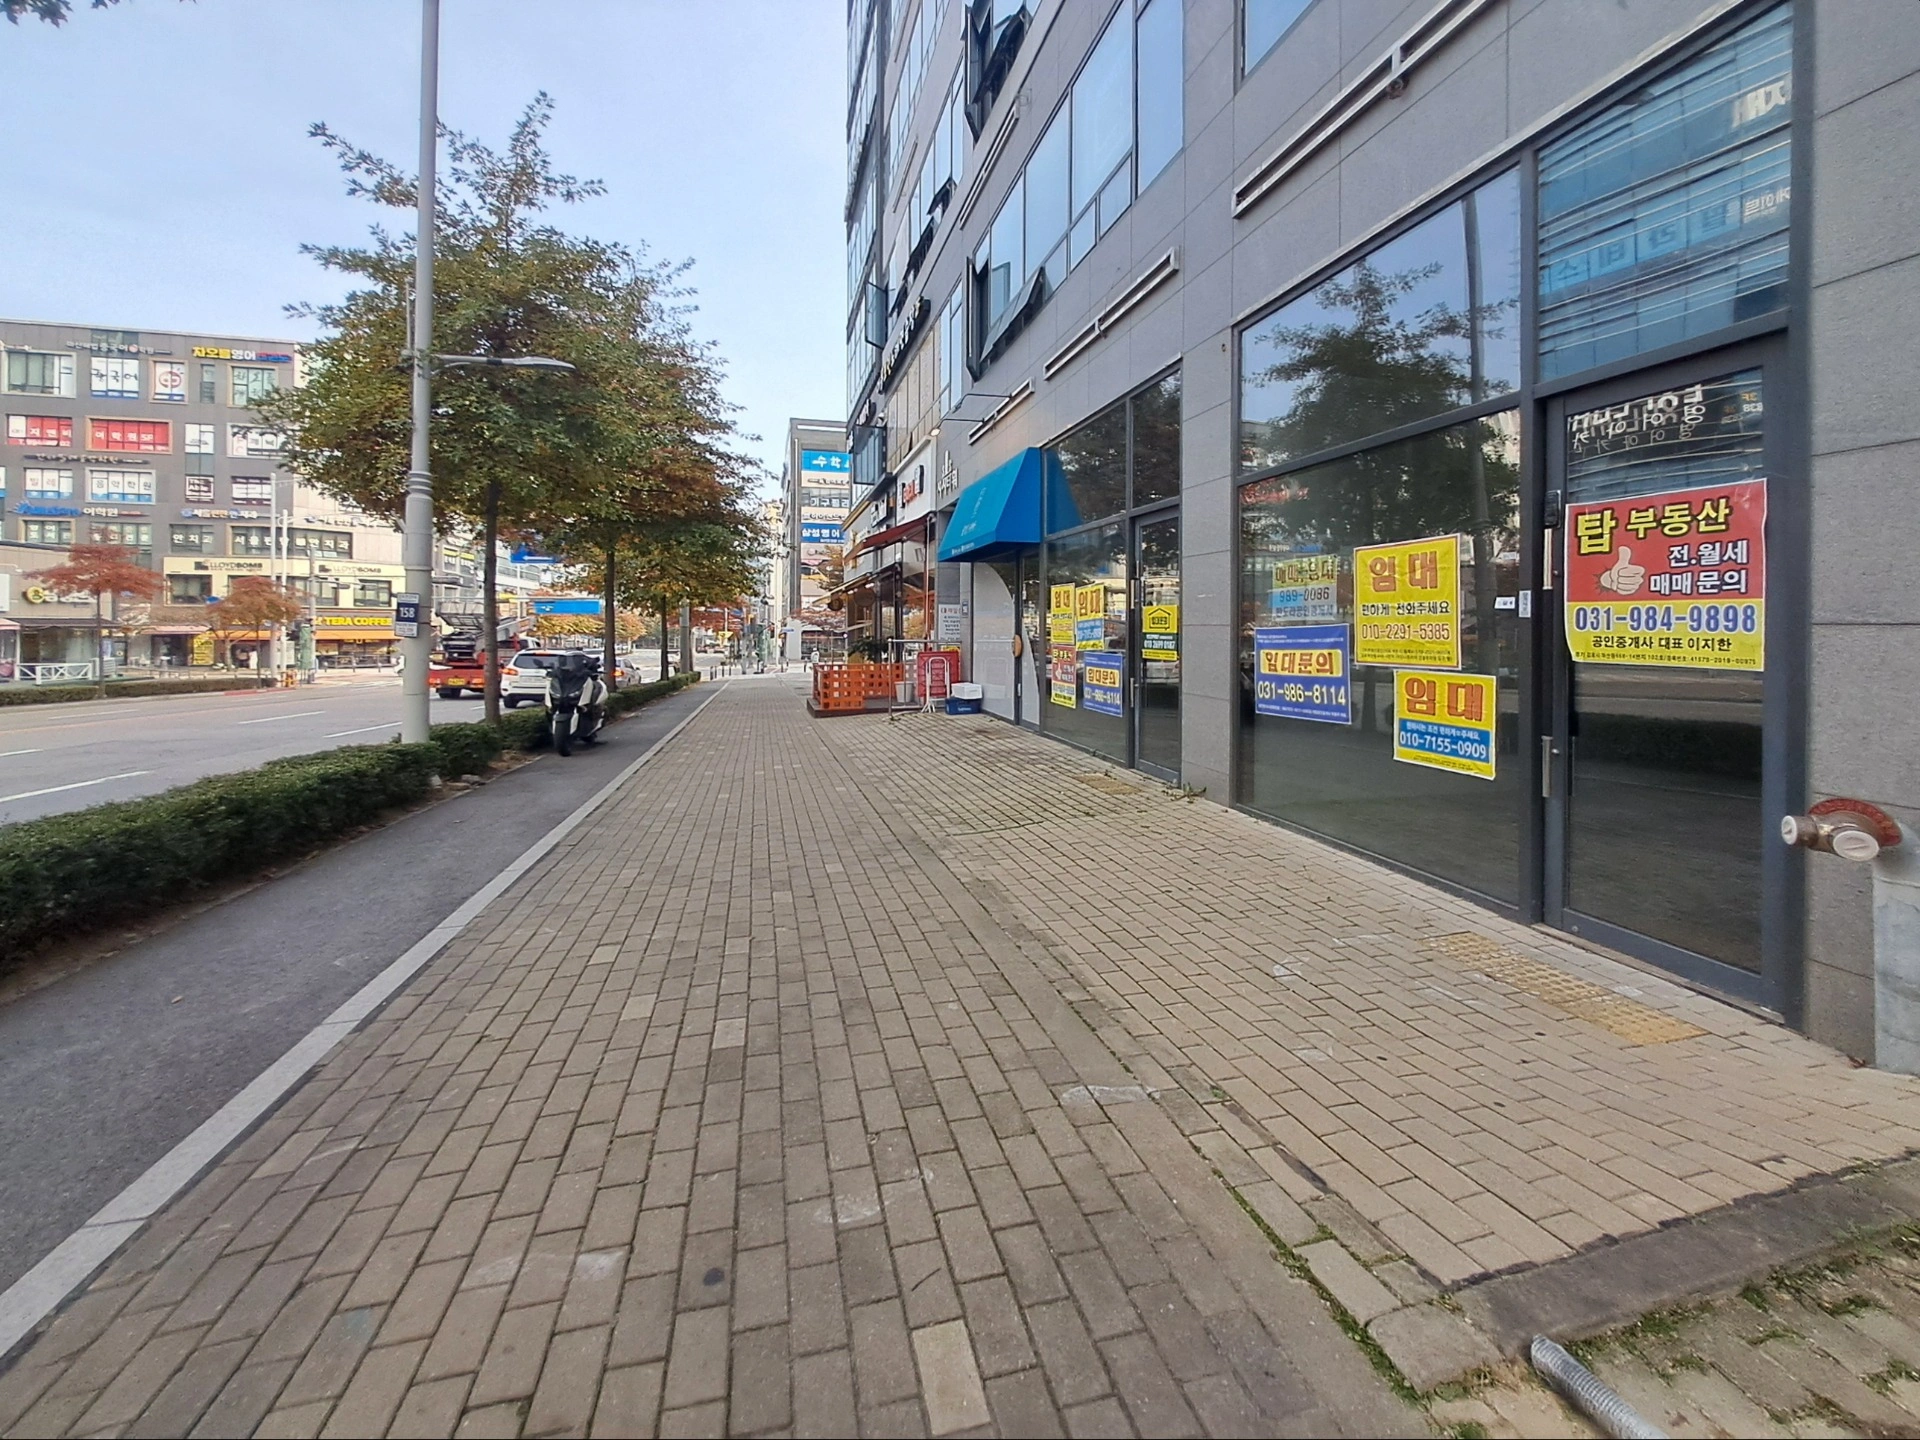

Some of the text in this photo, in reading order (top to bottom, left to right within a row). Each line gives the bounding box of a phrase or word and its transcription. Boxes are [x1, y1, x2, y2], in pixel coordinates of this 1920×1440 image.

[1626, 498, 1731, 539] 부동산
[1576, 509, 1616, 554] 탑
[1668, 540, 1748, 568] 전.월세
[1369, 551, 1439, 592] 임대
[1649, 570, 1747, 595] 매매 문의
[400, 607, 415, 618] 158
[1396, 601, 1450, 616] 전화주세요
[1574, 604, 1756, 633] 031-984-9898
[354, 617, 393, 626] COFFEE
[1361, 623, 1450, 641] 010-2291-5385
[1592, 635, 1732, 652] 공인중개사 대표 이지한
[1264, 651, 1335, 675] 임대문의
[1257, 681, 1346, 706] 031-986-8114
[1405, 677, 1484, 721] 임대
[1399, 731, 1487, 760] 010-7155-0909
